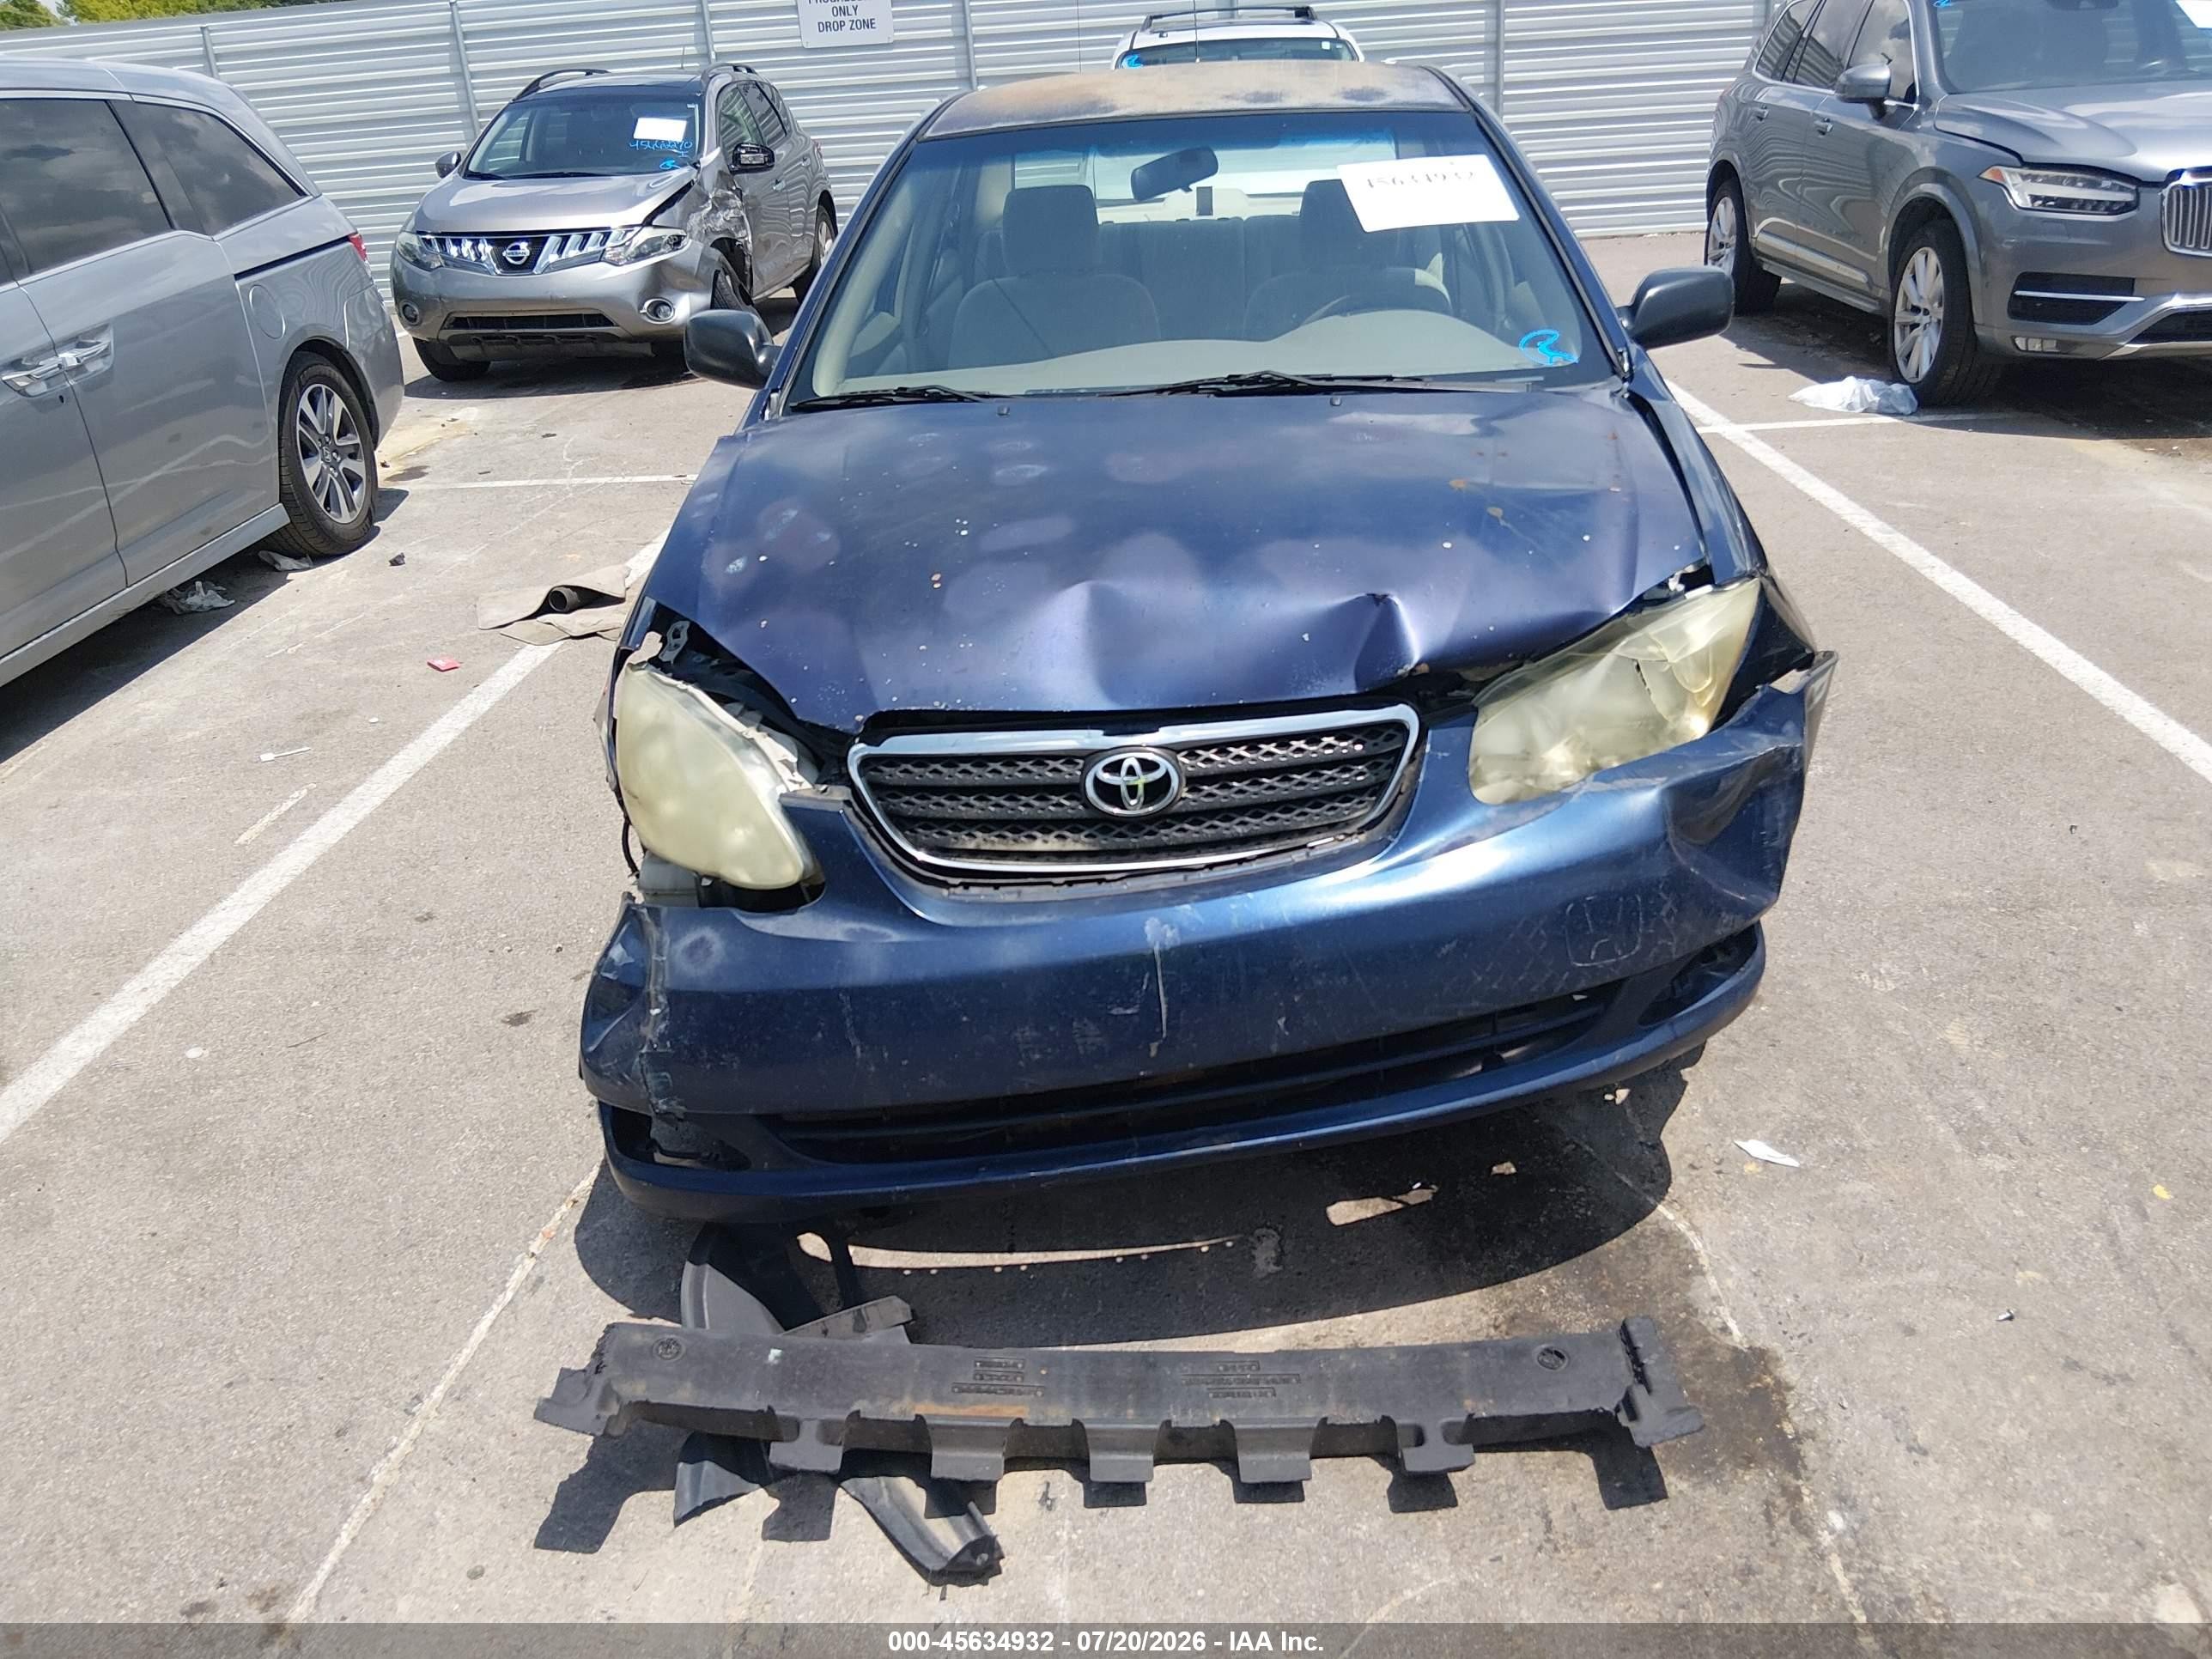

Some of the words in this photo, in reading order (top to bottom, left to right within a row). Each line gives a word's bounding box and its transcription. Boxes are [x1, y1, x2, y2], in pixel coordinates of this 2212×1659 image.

[831, 5, 859, 17] ONLY
[817, 20, 846, 33] DROP
[849, 18, 877, 31] ZONE
